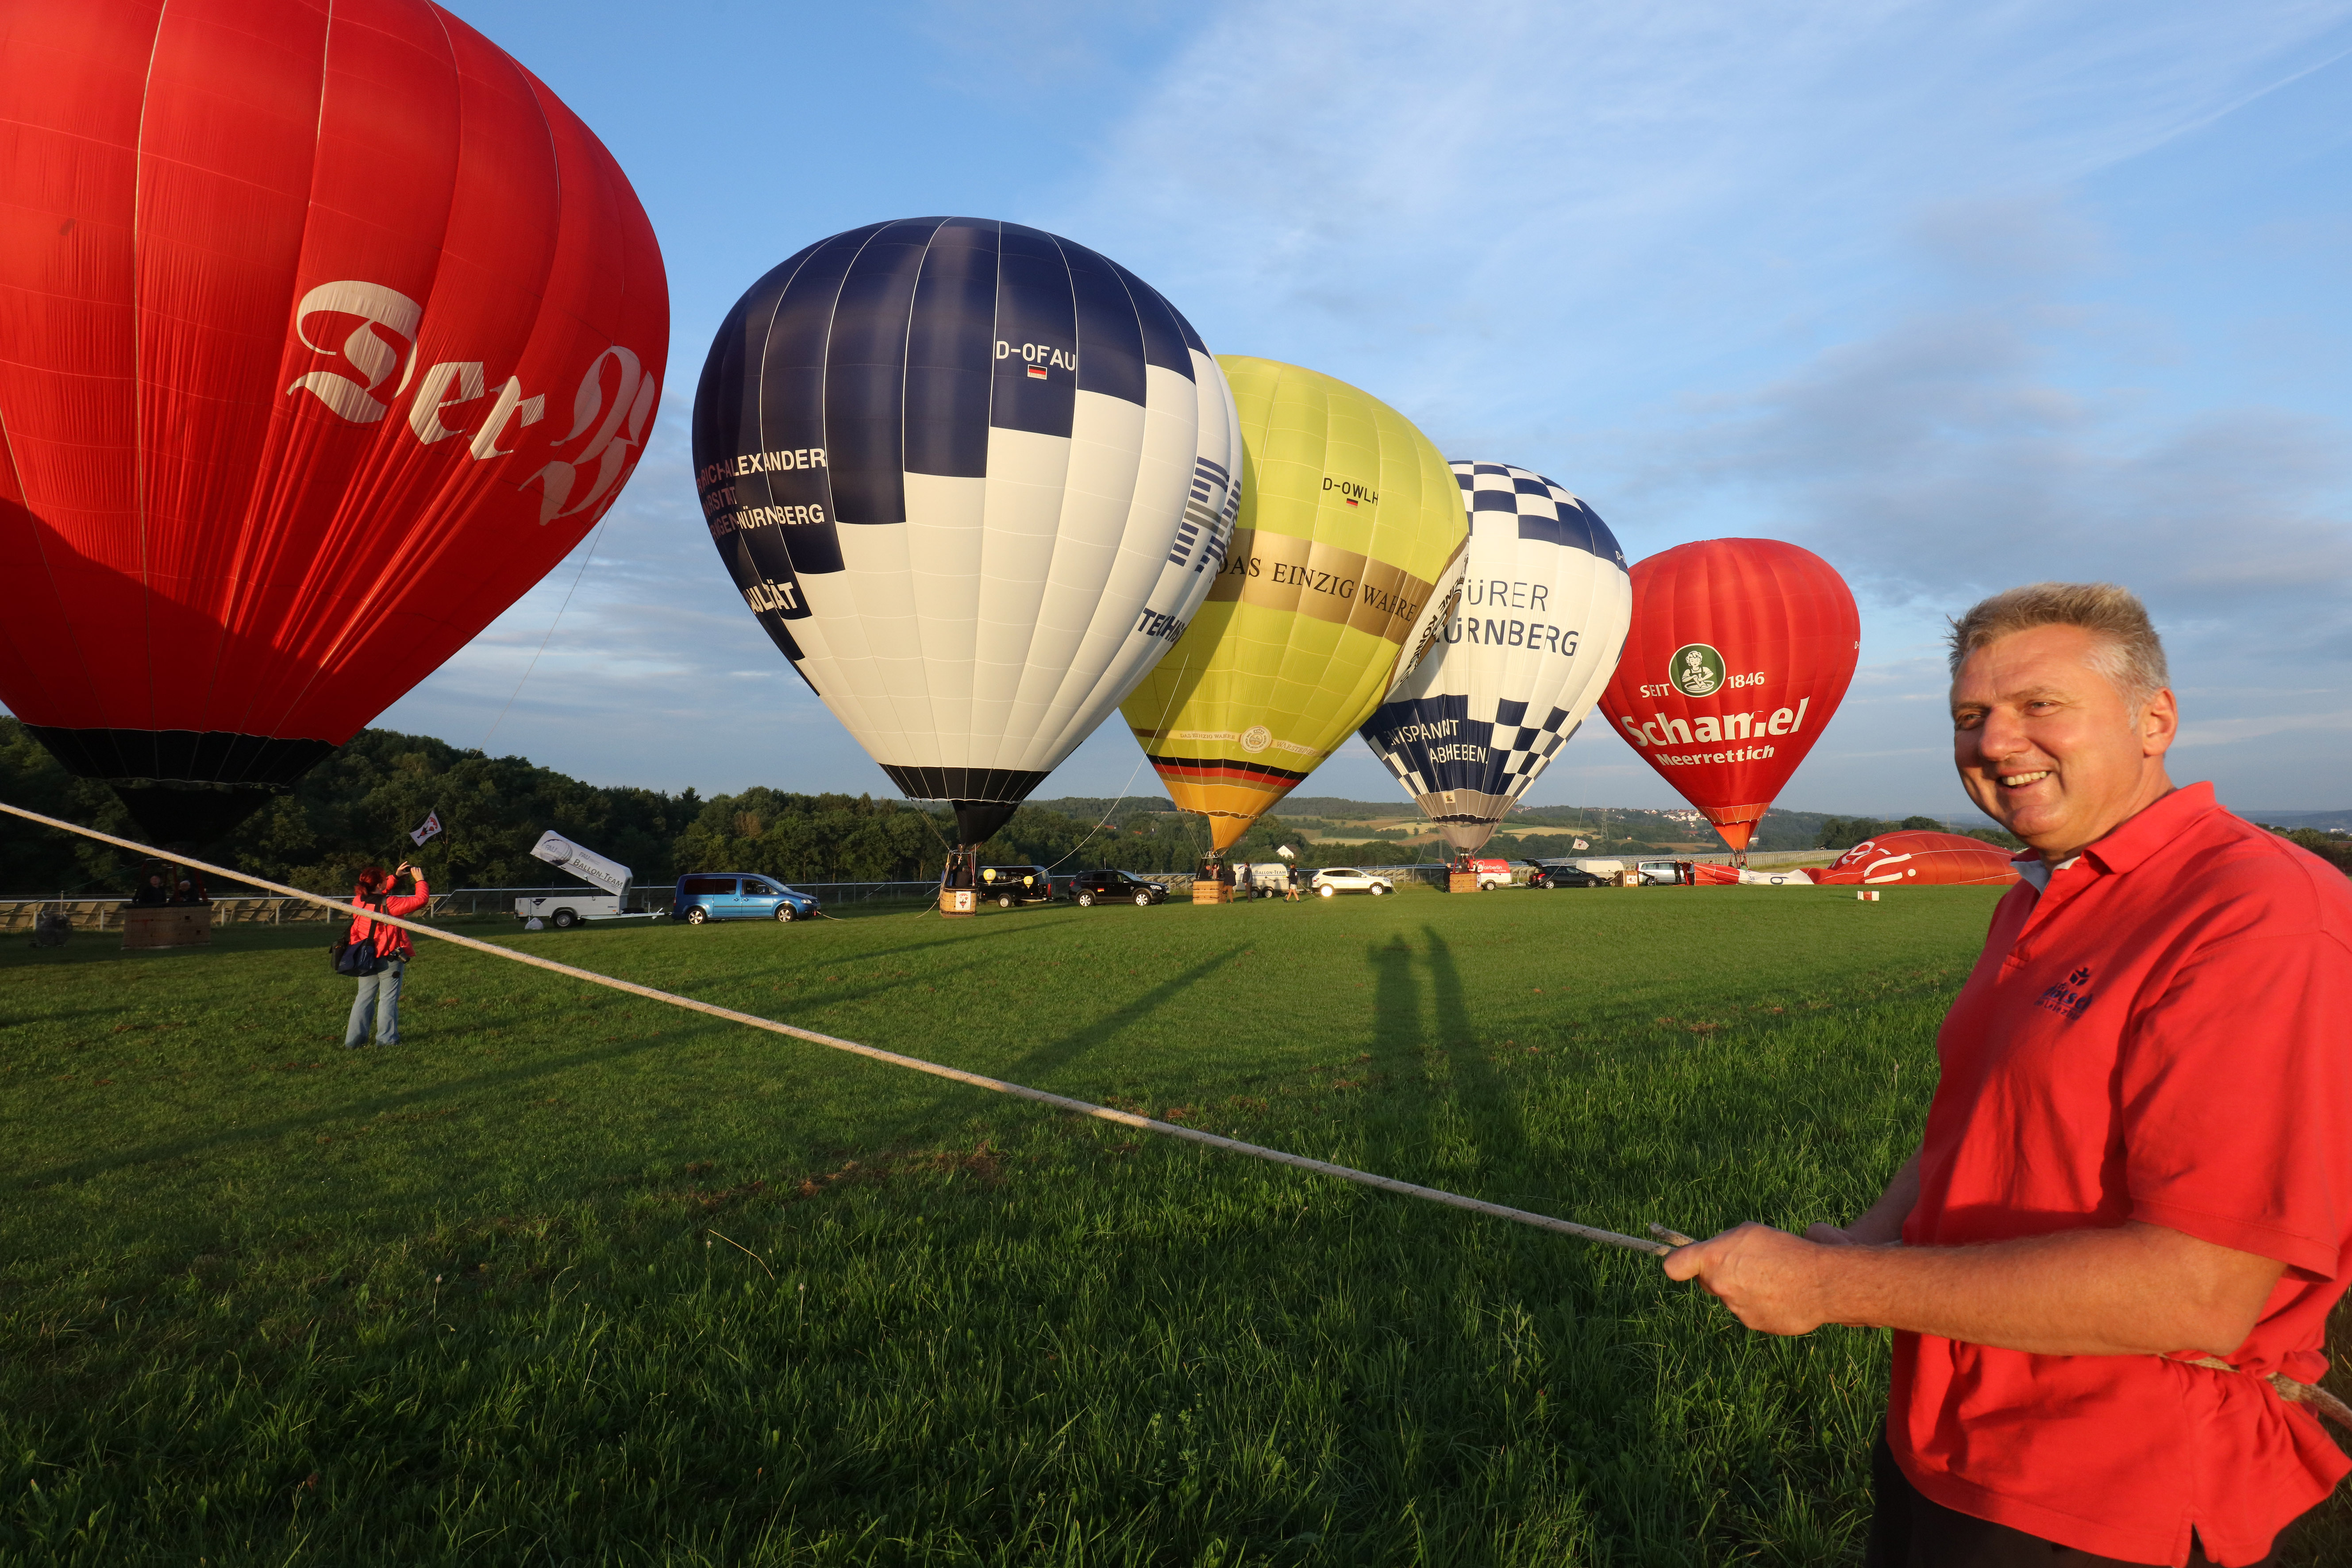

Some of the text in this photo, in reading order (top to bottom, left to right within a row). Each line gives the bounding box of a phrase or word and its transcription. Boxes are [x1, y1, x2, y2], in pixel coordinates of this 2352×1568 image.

[286, 280, 545, 461] Der
[996, 341, 1075, 371] D-OFAU
[1323, 477, 1378, 506] D-OWLH
[1271, 562, 1354, 598] EINZIG
[1363, 584, 1417, 622] WAHRE
[1457, 579, 1548, 611] ÜRER
[1435, 617, 1579, 657] ÜRNBERG
[1640, 671, 1765, 698] SEIT 1846
[1621, 696, 1810, 747] Schamel
[1429, 744, 1489, 765] ABHEBEN.
[1654, 745, 1775, 766] Meerrettich
[545, 844, 558, 853] FAU
